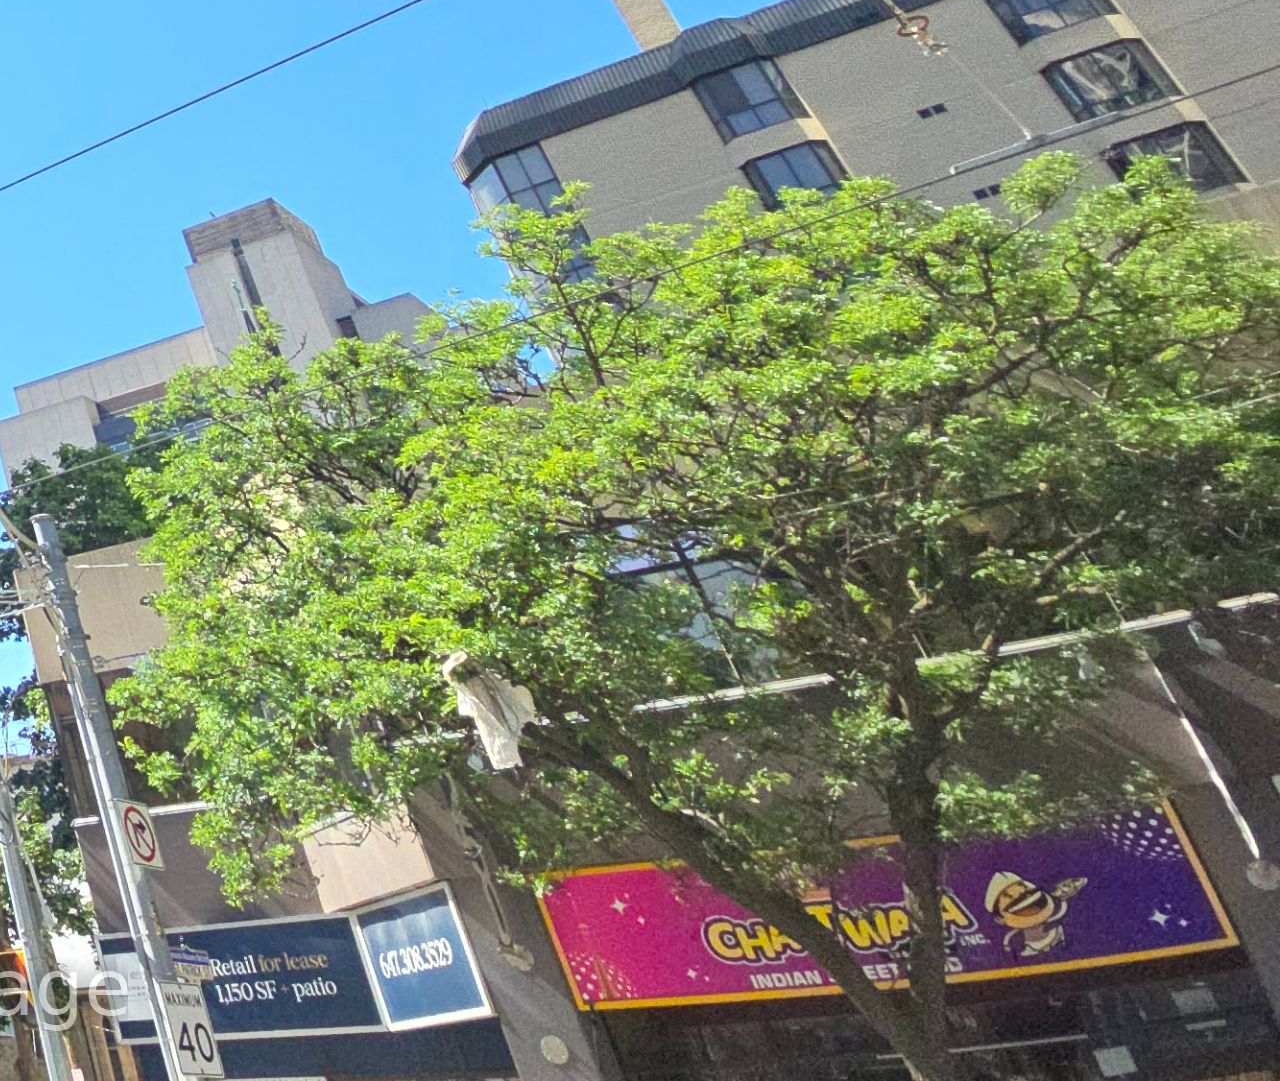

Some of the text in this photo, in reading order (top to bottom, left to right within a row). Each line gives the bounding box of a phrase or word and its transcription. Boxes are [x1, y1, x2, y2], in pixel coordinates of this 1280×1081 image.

[209, 952, 329, 977] Retail for lease
[215, 982, 254, 1005] 1,150
[255, 980, 277, 1000] SF
[292, 976, 338, 1002] patio
[750, 970, 822, 989] INDIAN
[163, 991, 203, 1008] MAXIMUM
[178, 1022, 215, 1063] 40
